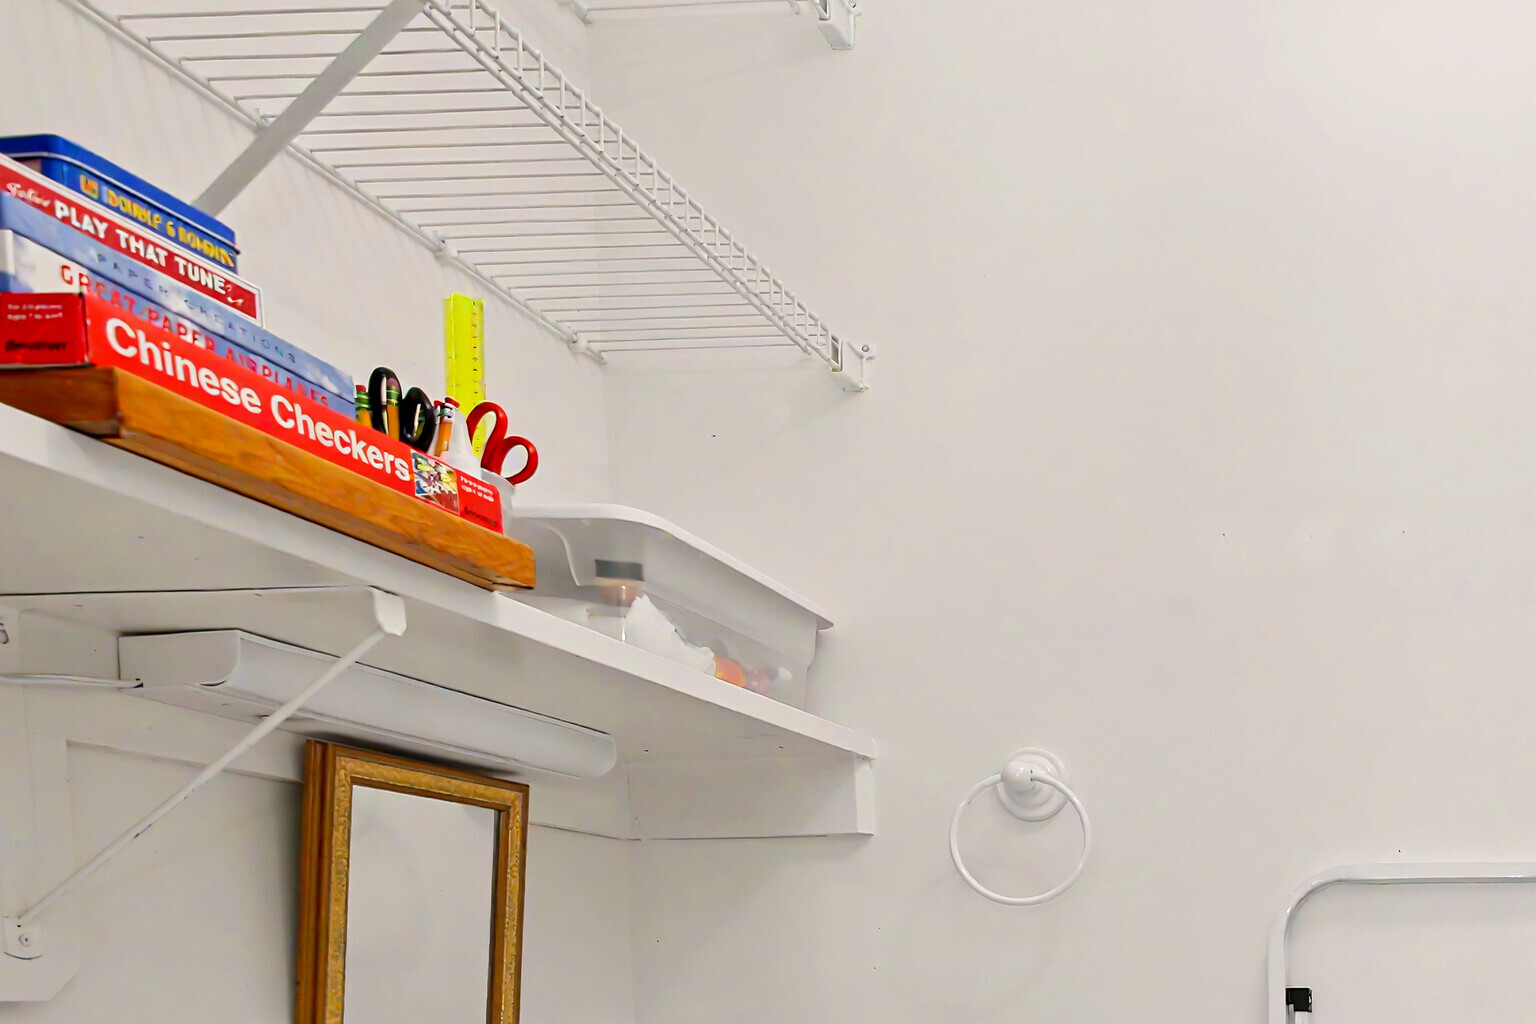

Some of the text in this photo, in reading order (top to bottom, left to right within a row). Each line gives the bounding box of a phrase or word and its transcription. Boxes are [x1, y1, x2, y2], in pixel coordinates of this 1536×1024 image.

[54, 199, 109, 239] PLAY
[115, 228, 169, 268] THAT
[106, 317, 411, 482] Chinese Checkers
